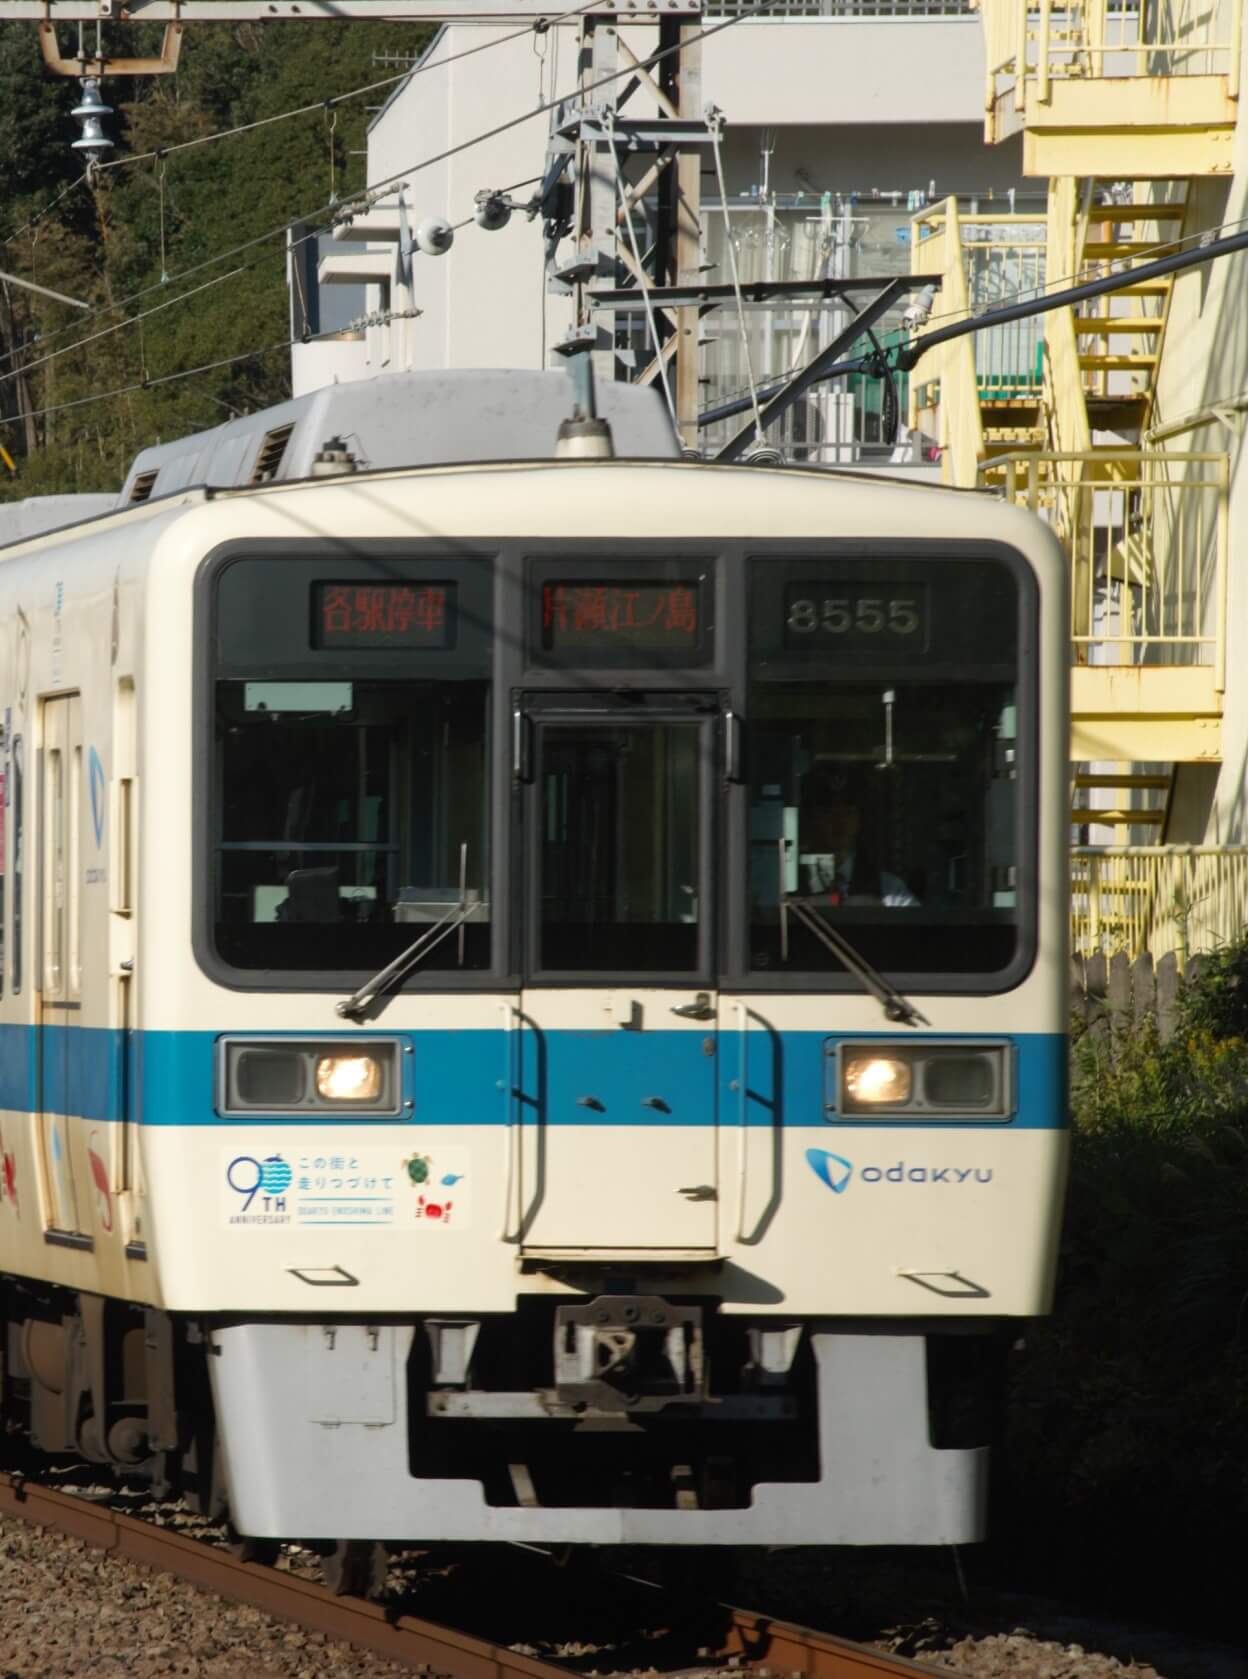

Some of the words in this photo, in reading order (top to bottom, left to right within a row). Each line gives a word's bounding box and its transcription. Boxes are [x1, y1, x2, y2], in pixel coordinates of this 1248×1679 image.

[786, 599, 919, 634] 8555
[299, 1156, 359, 1170] この街と
[298, 1176, 393, 1190] 走りつづけて
[229, 1215, 291, 1225] ANNIVERSARY
